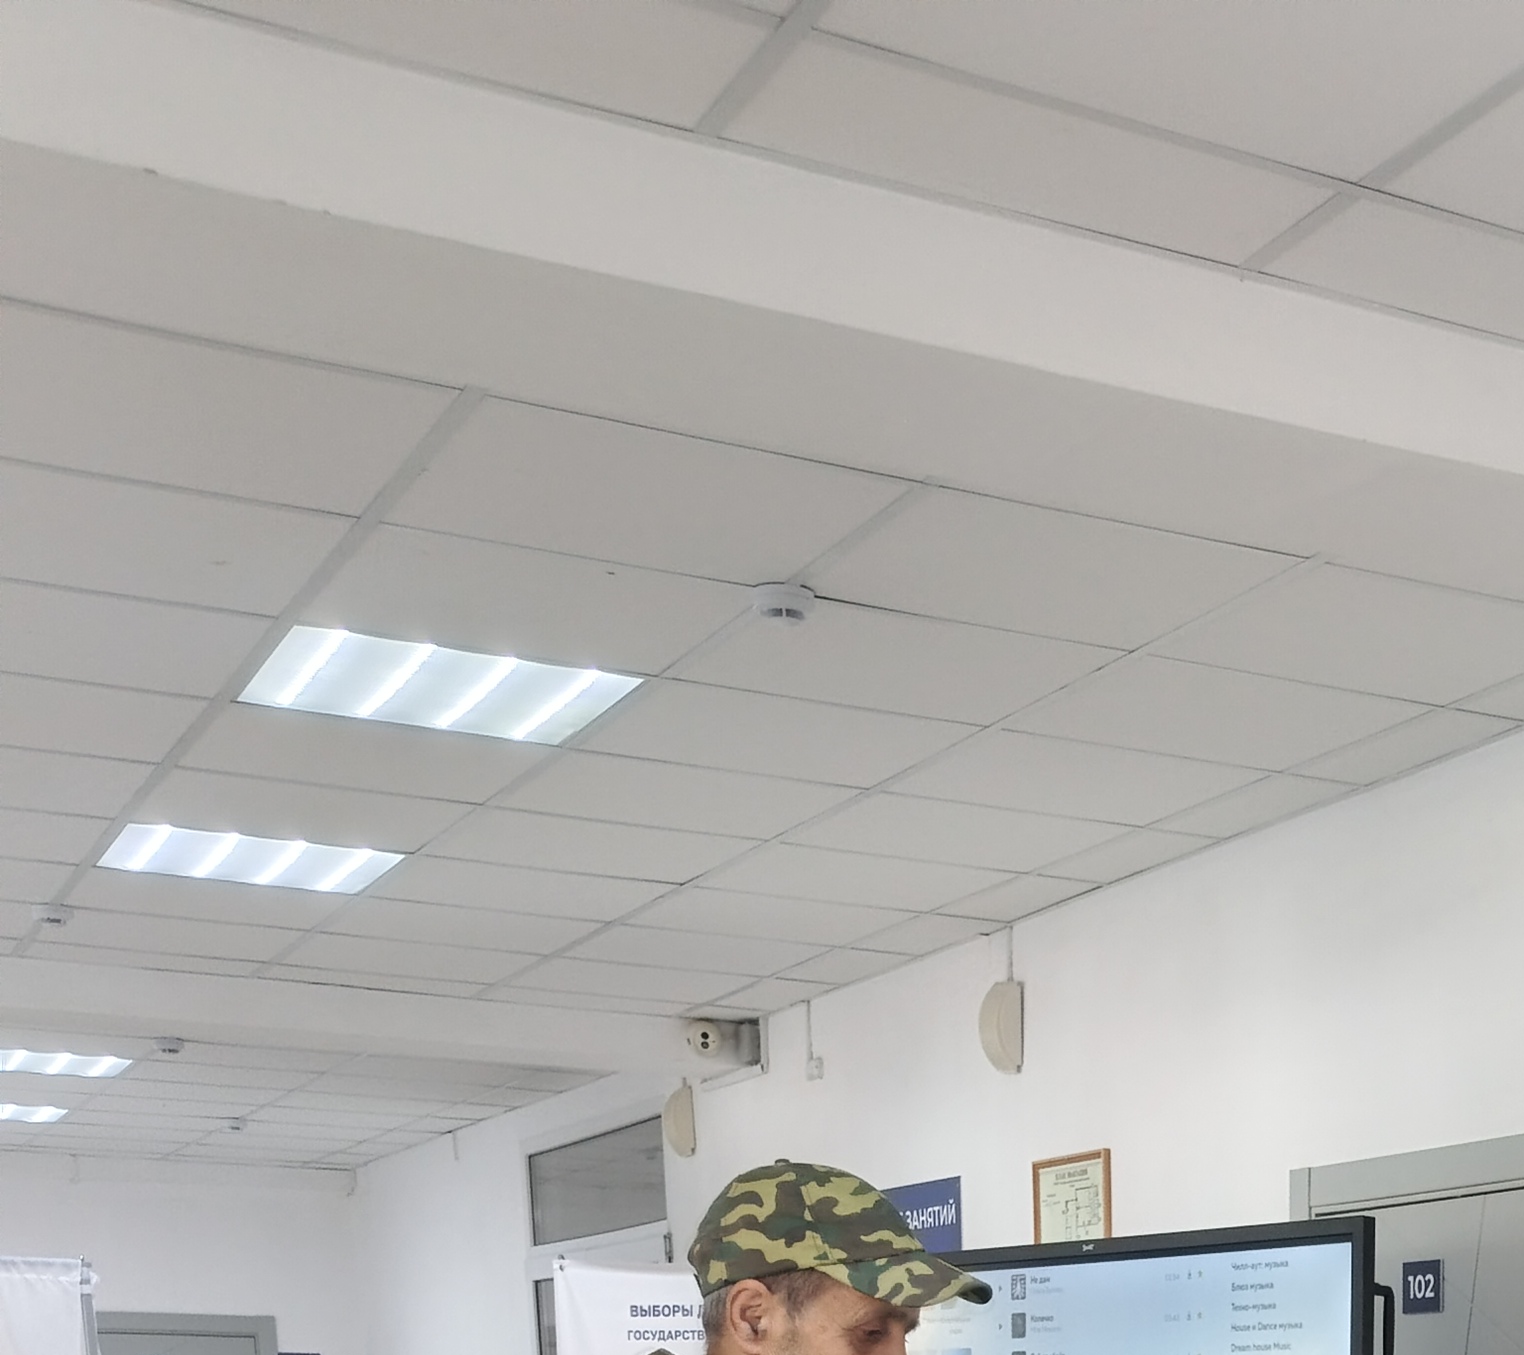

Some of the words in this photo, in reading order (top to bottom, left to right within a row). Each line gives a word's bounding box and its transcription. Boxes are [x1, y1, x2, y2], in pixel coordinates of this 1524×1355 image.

[906, 1199, 956, 1230] ЗАНЯТИЙ
[1407, 1273, 1435, 1299] 102
[629, 1304, 694, 1317] ВЫБОРЫ
[627, 1329, 705, 1342] ГОСУДАРСТВ
